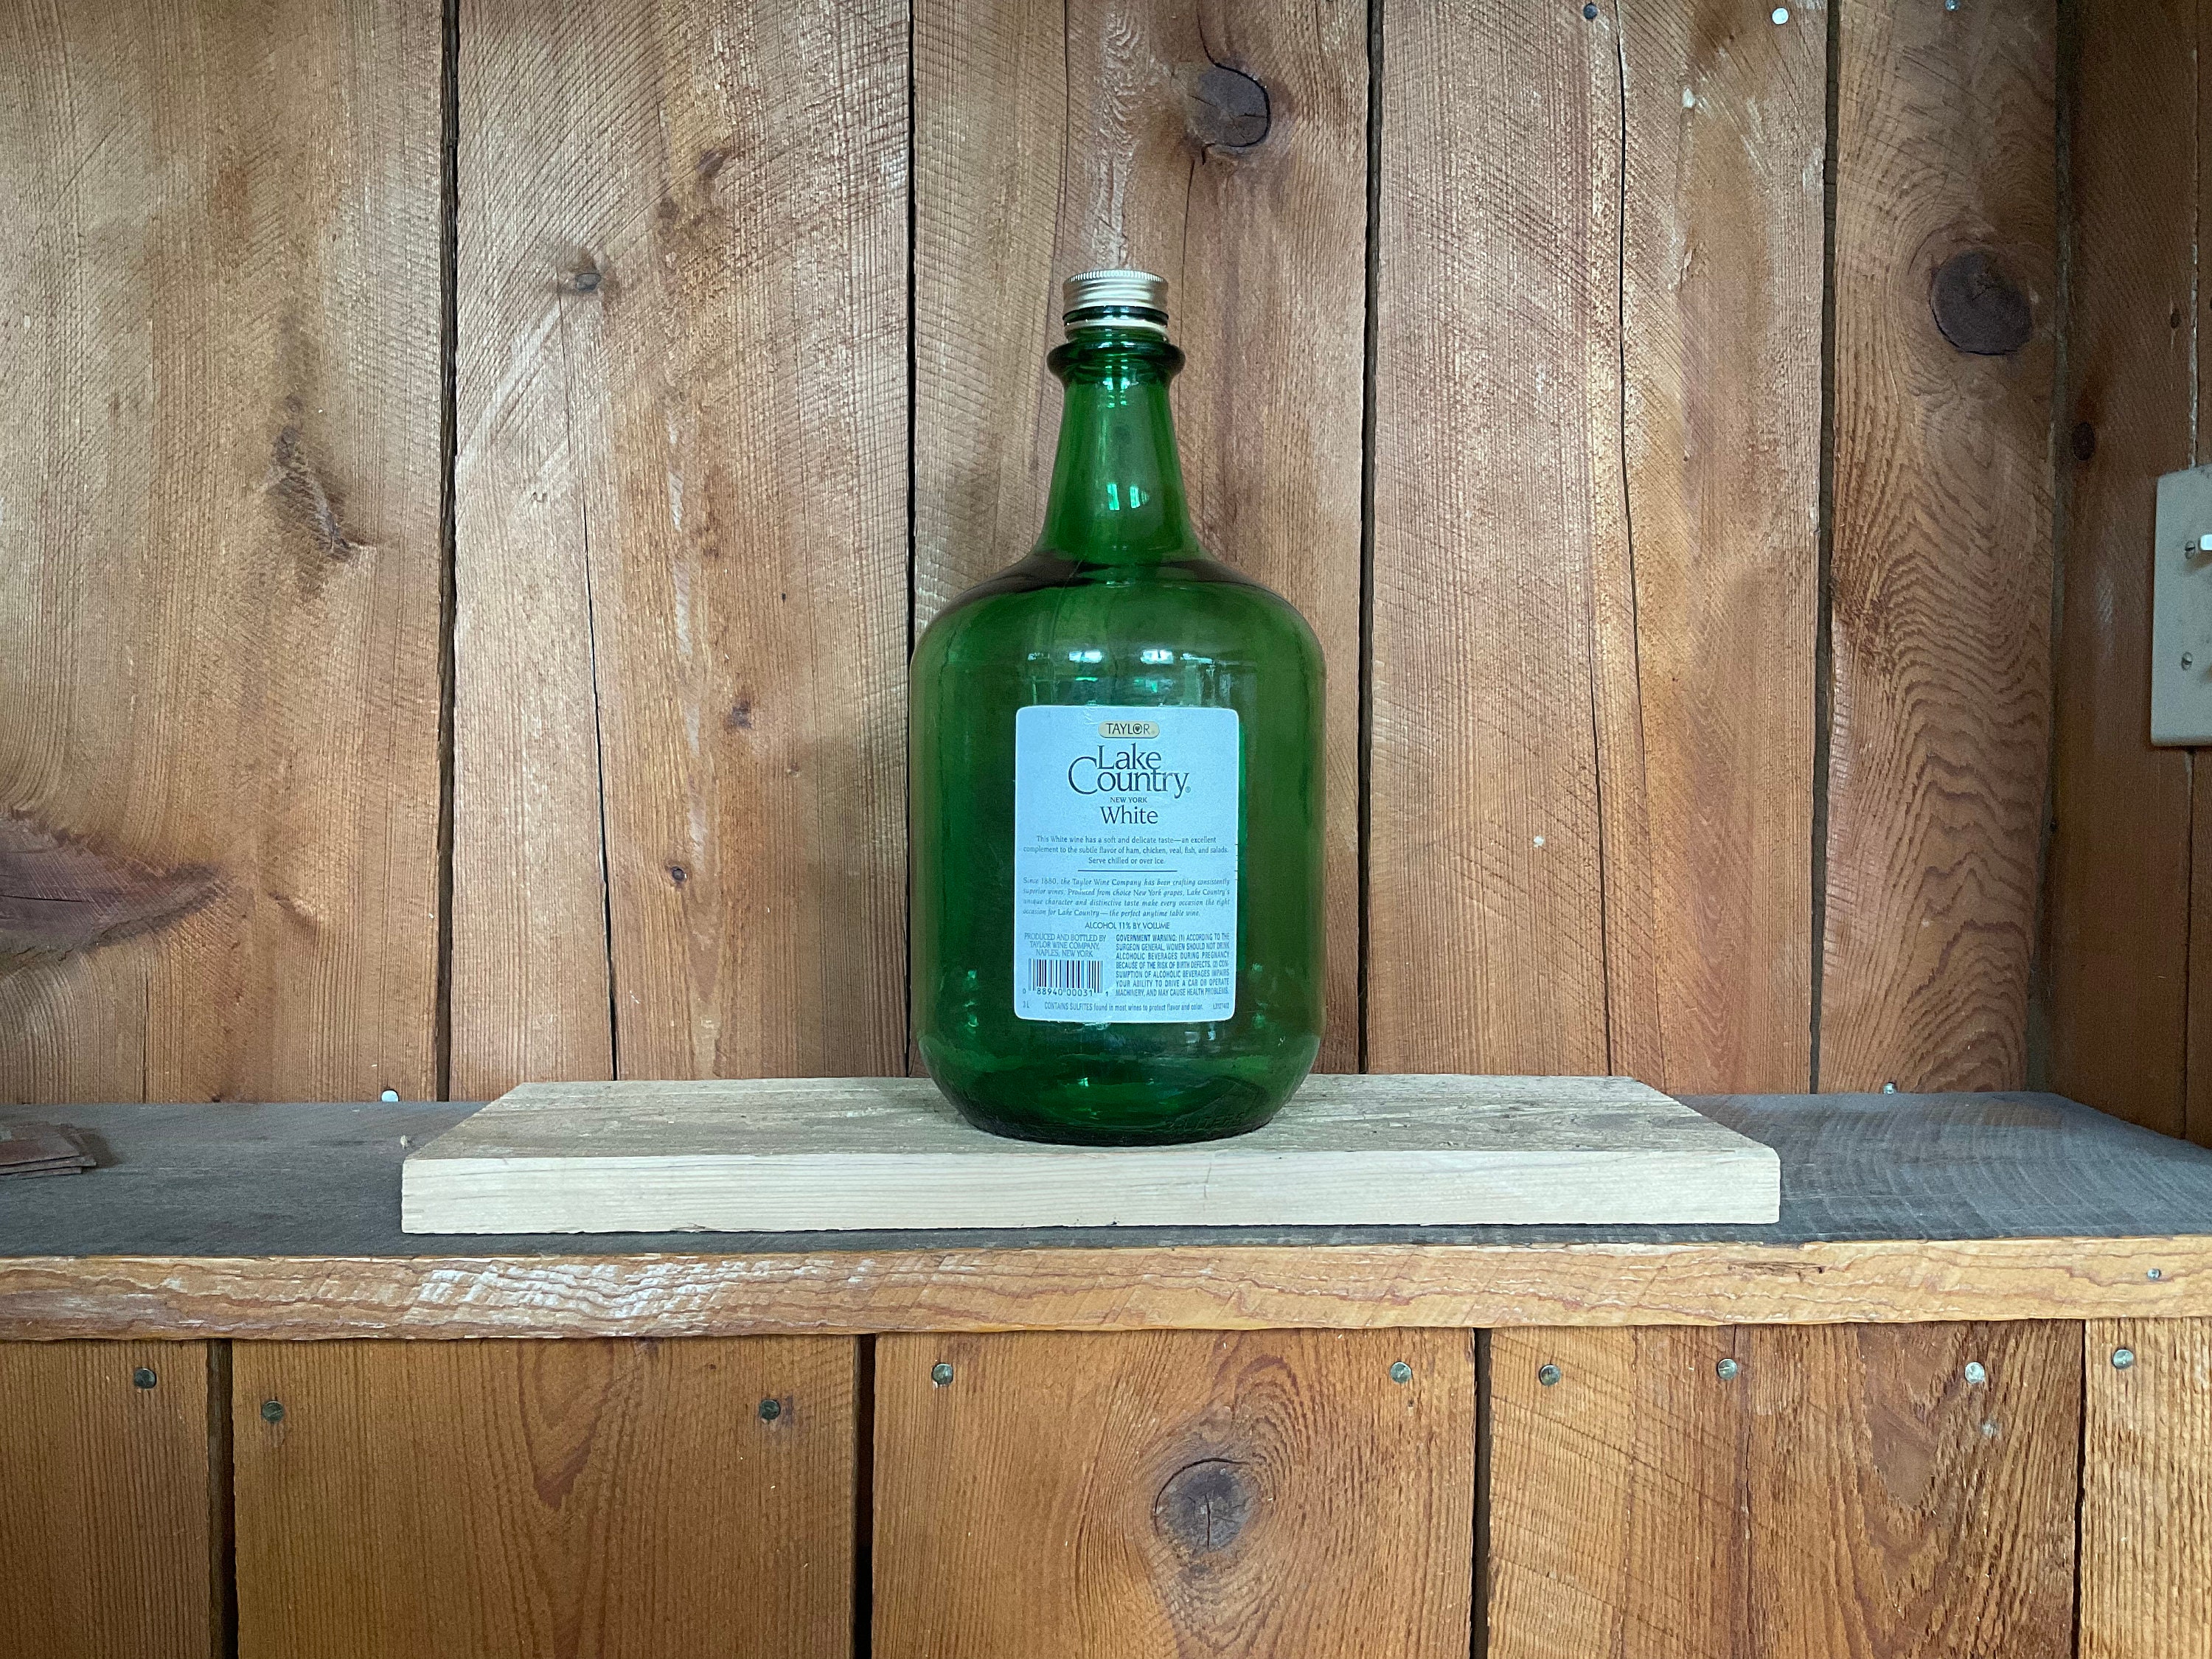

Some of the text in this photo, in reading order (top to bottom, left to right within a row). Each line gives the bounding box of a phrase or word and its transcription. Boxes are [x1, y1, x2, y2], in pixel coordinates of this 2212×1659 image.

[1106, 723, 1150, 734] TAYLOR
[1098, 743, 1161, 770] Lake
[1068, 757, 1189, 799] Country
[1100, 806, 1158, 824] White
[1217, 898, 1230, 906] right
